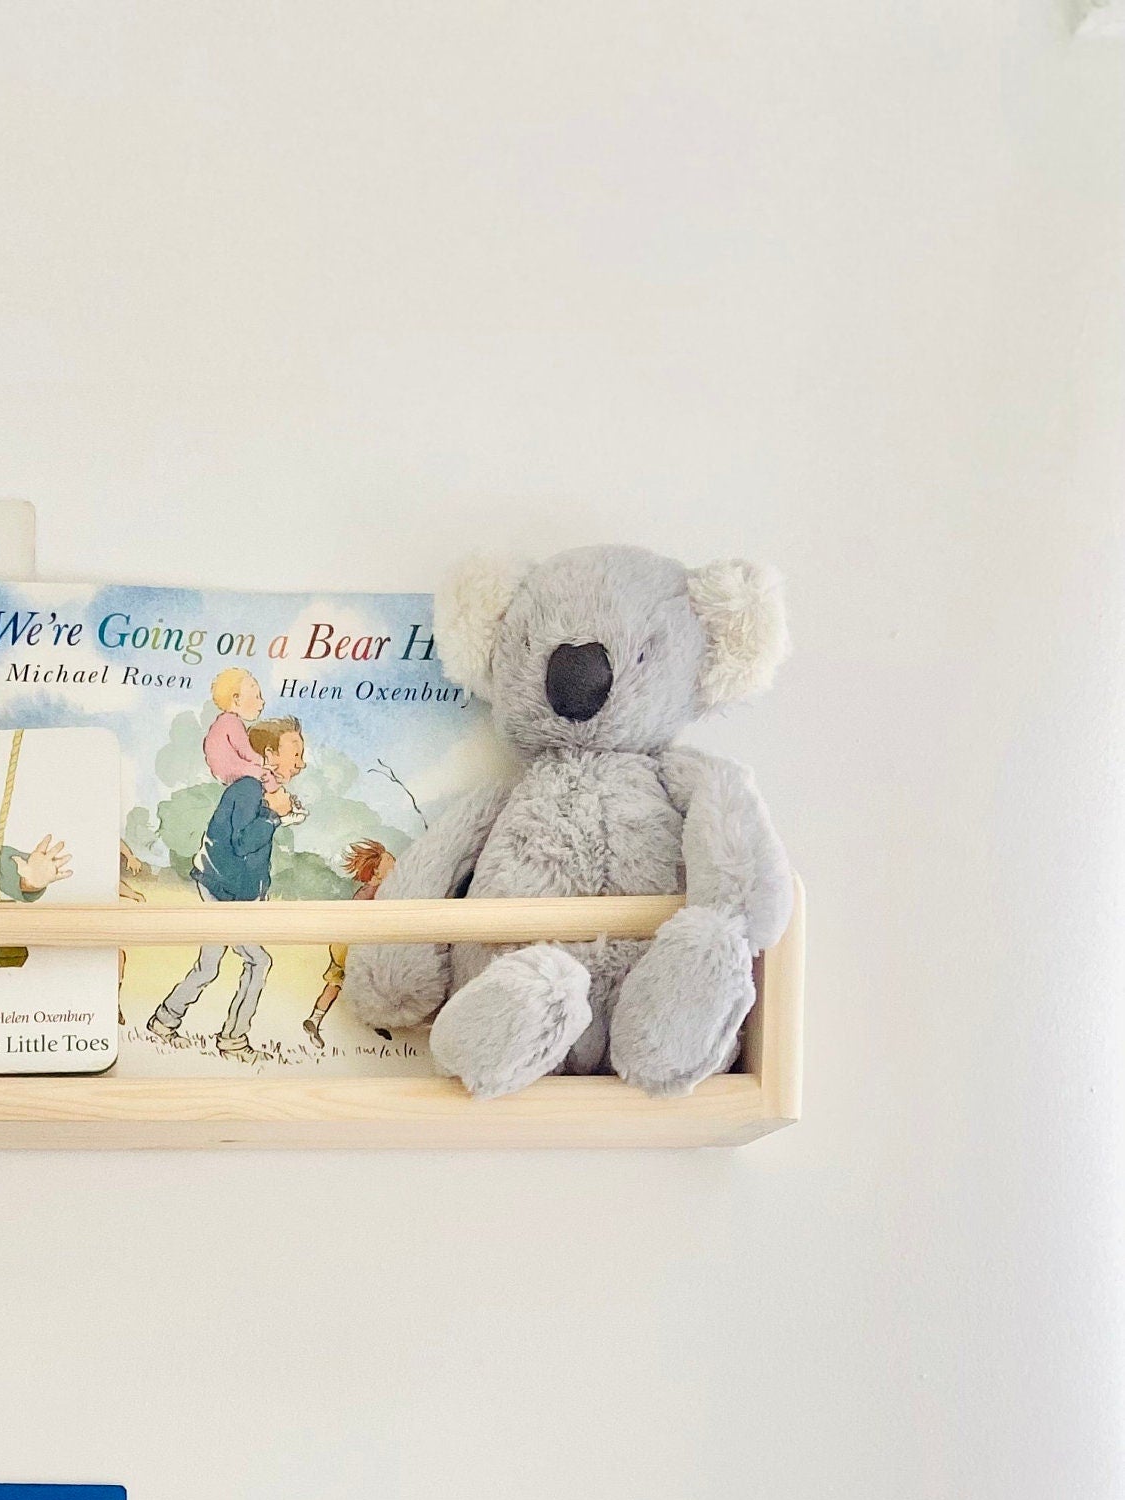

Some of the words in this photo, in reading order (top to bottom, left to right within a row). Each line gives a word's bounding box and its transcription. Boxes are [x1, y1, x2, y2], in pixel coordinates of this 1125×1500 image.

[97, 612, 208, 665] Going
[216, 632, 256, 657] on
[268, 635, 289, 660] a
[301, 623, 392, 661] Bear
[5, 663, 109, 684] Michael
[121, 666, 192, 689] Rosen
[280, 678, 342, 700] Helen
[33, 1009, 95, 1025] Oxenbury
[6, 1034, 58, 1053] Little
[63, 1034, 110, 1052] Toes
